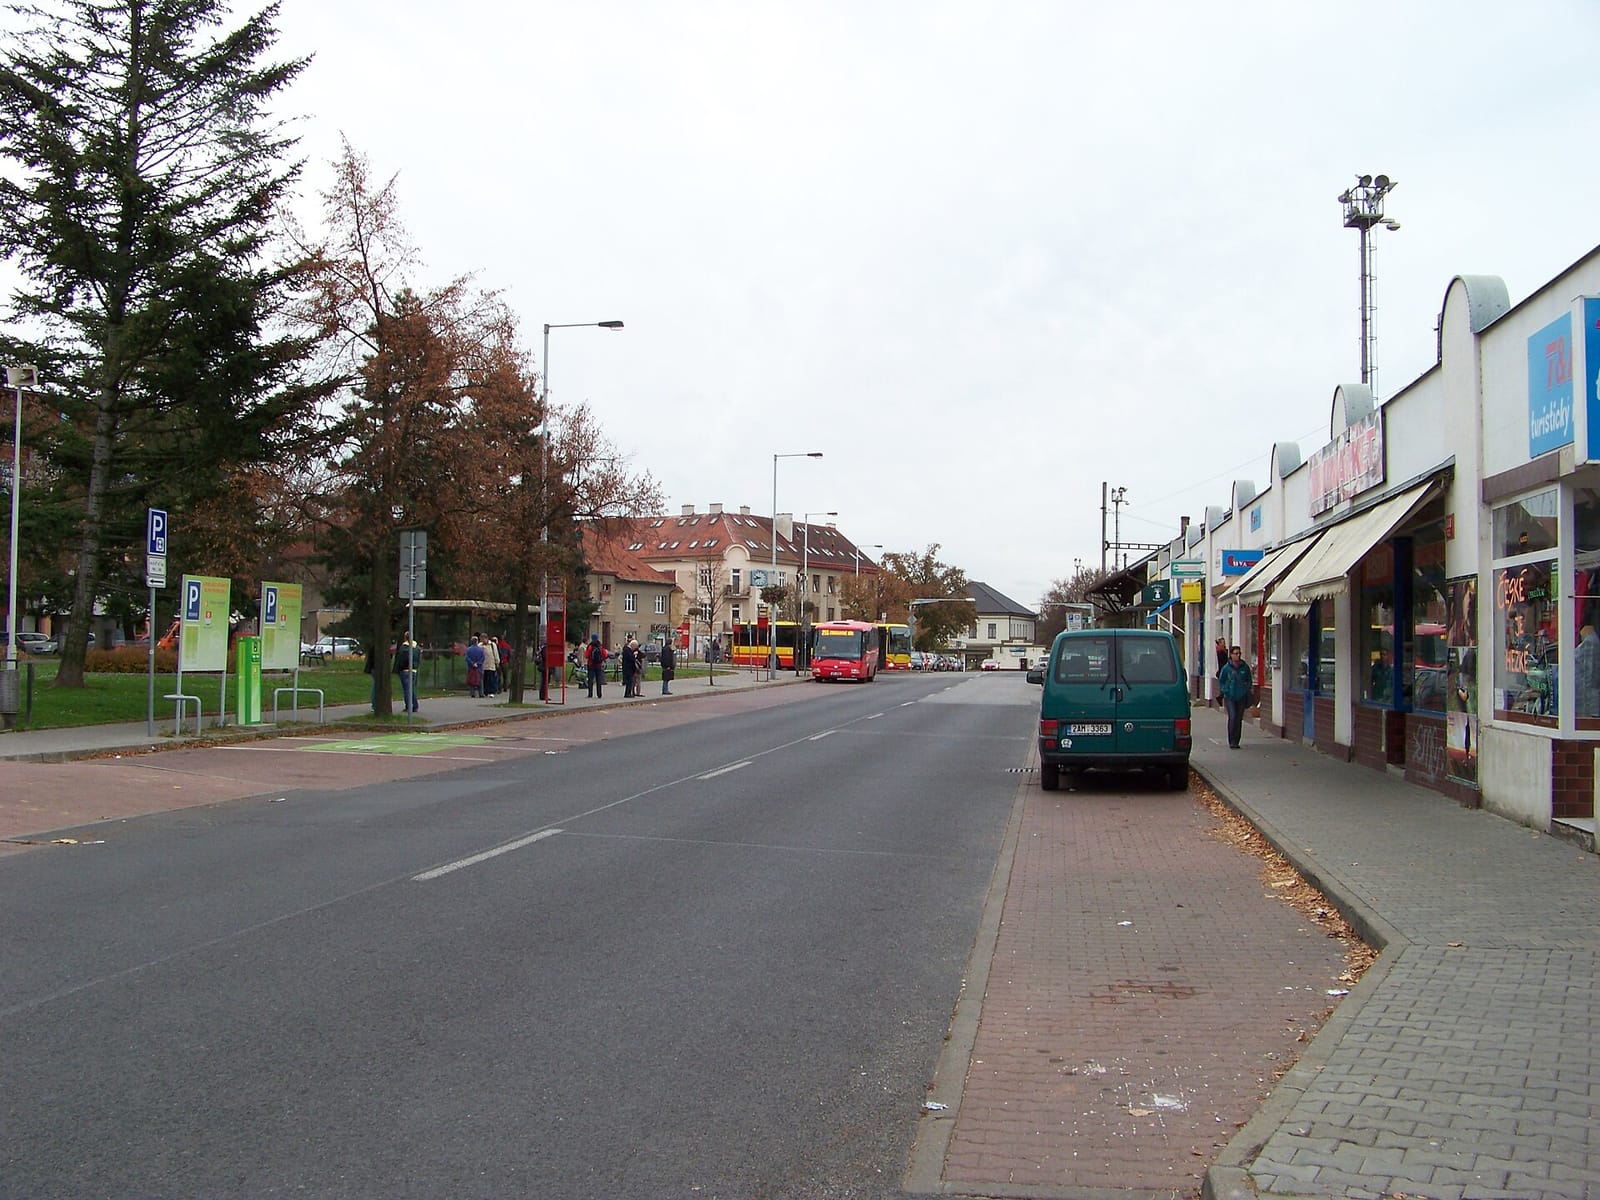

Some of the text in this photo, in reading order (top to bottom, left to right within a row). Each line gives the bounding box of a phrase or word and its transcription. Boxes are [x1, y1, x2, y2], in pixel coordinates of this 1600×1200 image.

[1531, 396, 1570, 440] turistický
[152, 515, 164, 541] P
[188, 585, 200, 611] P
[1497, 568, 1528, 609] ČESKÉ
[266, 591, 277, 615] P
[1514, 614, 1525, 637] JE
[1505, 644, 1530, 674] HEZKÉ
